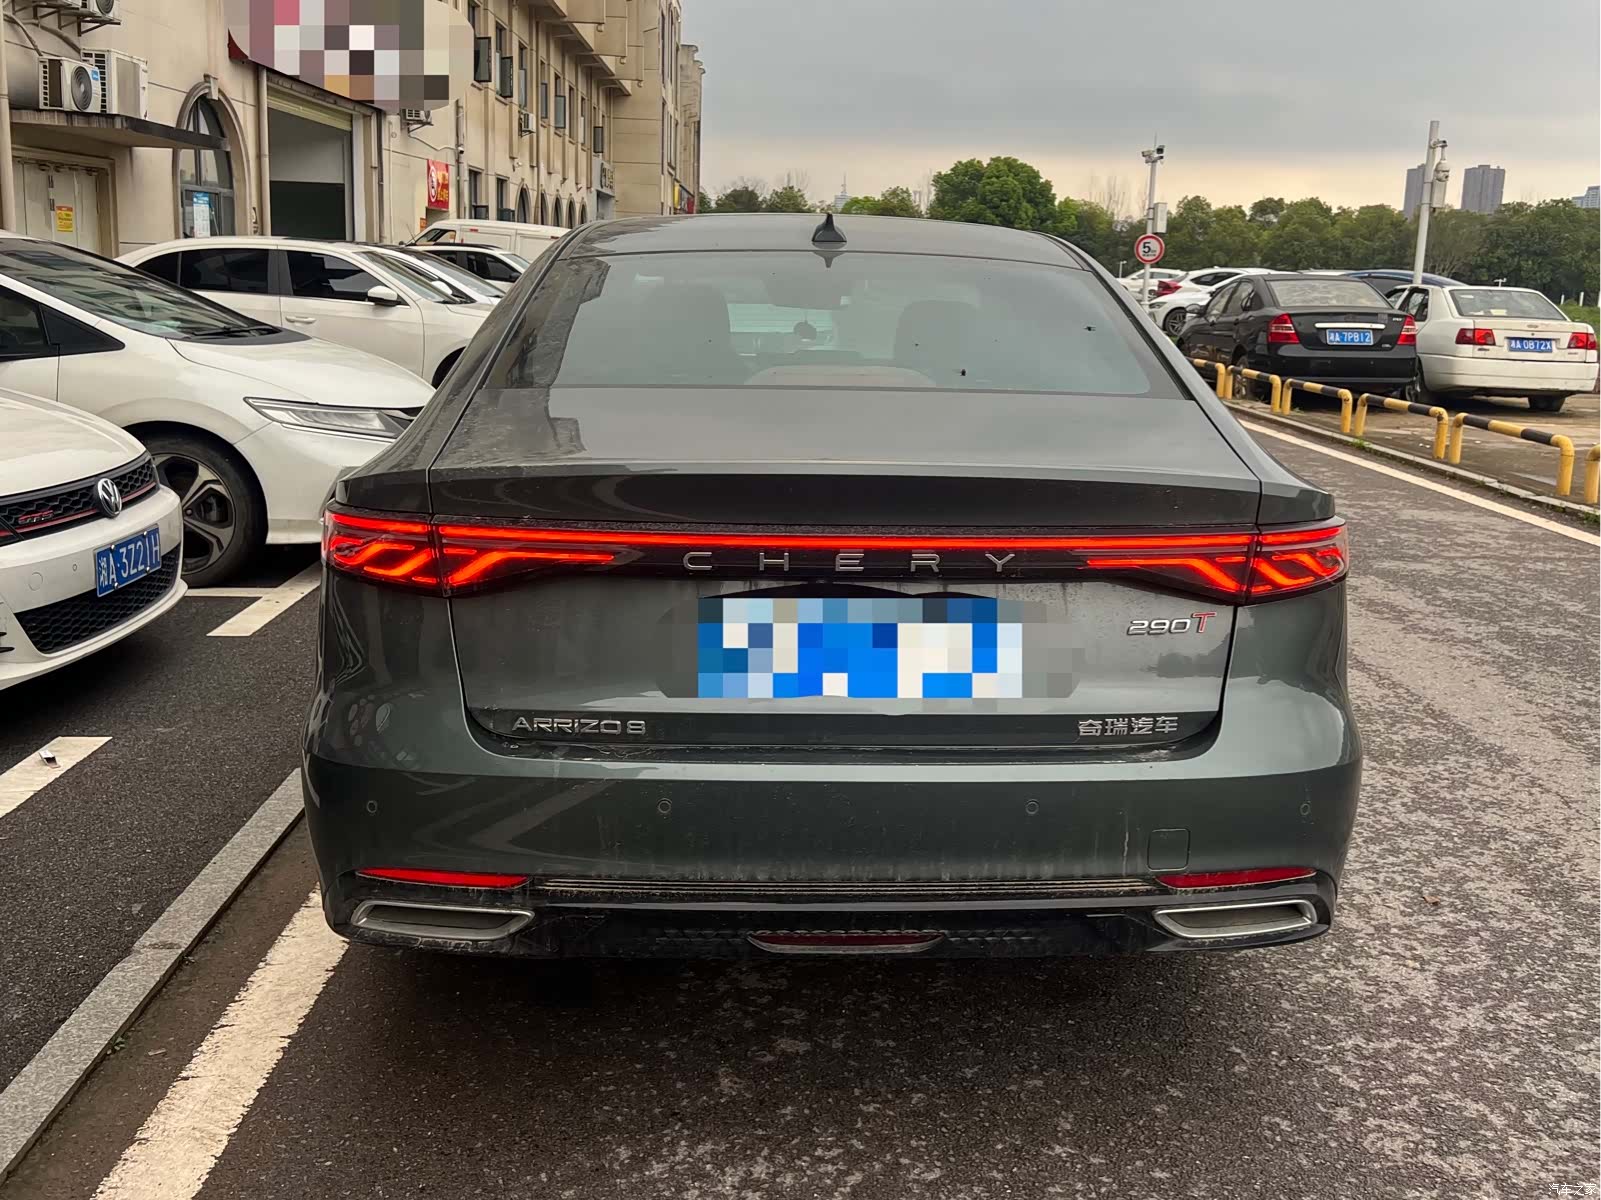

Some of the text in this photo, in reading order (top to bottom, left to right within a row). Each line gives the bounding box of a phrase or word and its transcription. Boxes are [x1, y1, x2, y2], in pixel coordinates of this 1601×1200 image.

[1142, 241, 1151, 254] 5
[682, 551, 1016, 573] CHERY
[1127, 611, 1217, 635] 290T
[511, 717, 646, 735] ARRIZO 8
[1078, 716, 1179, 737] 奇瑞汽车
